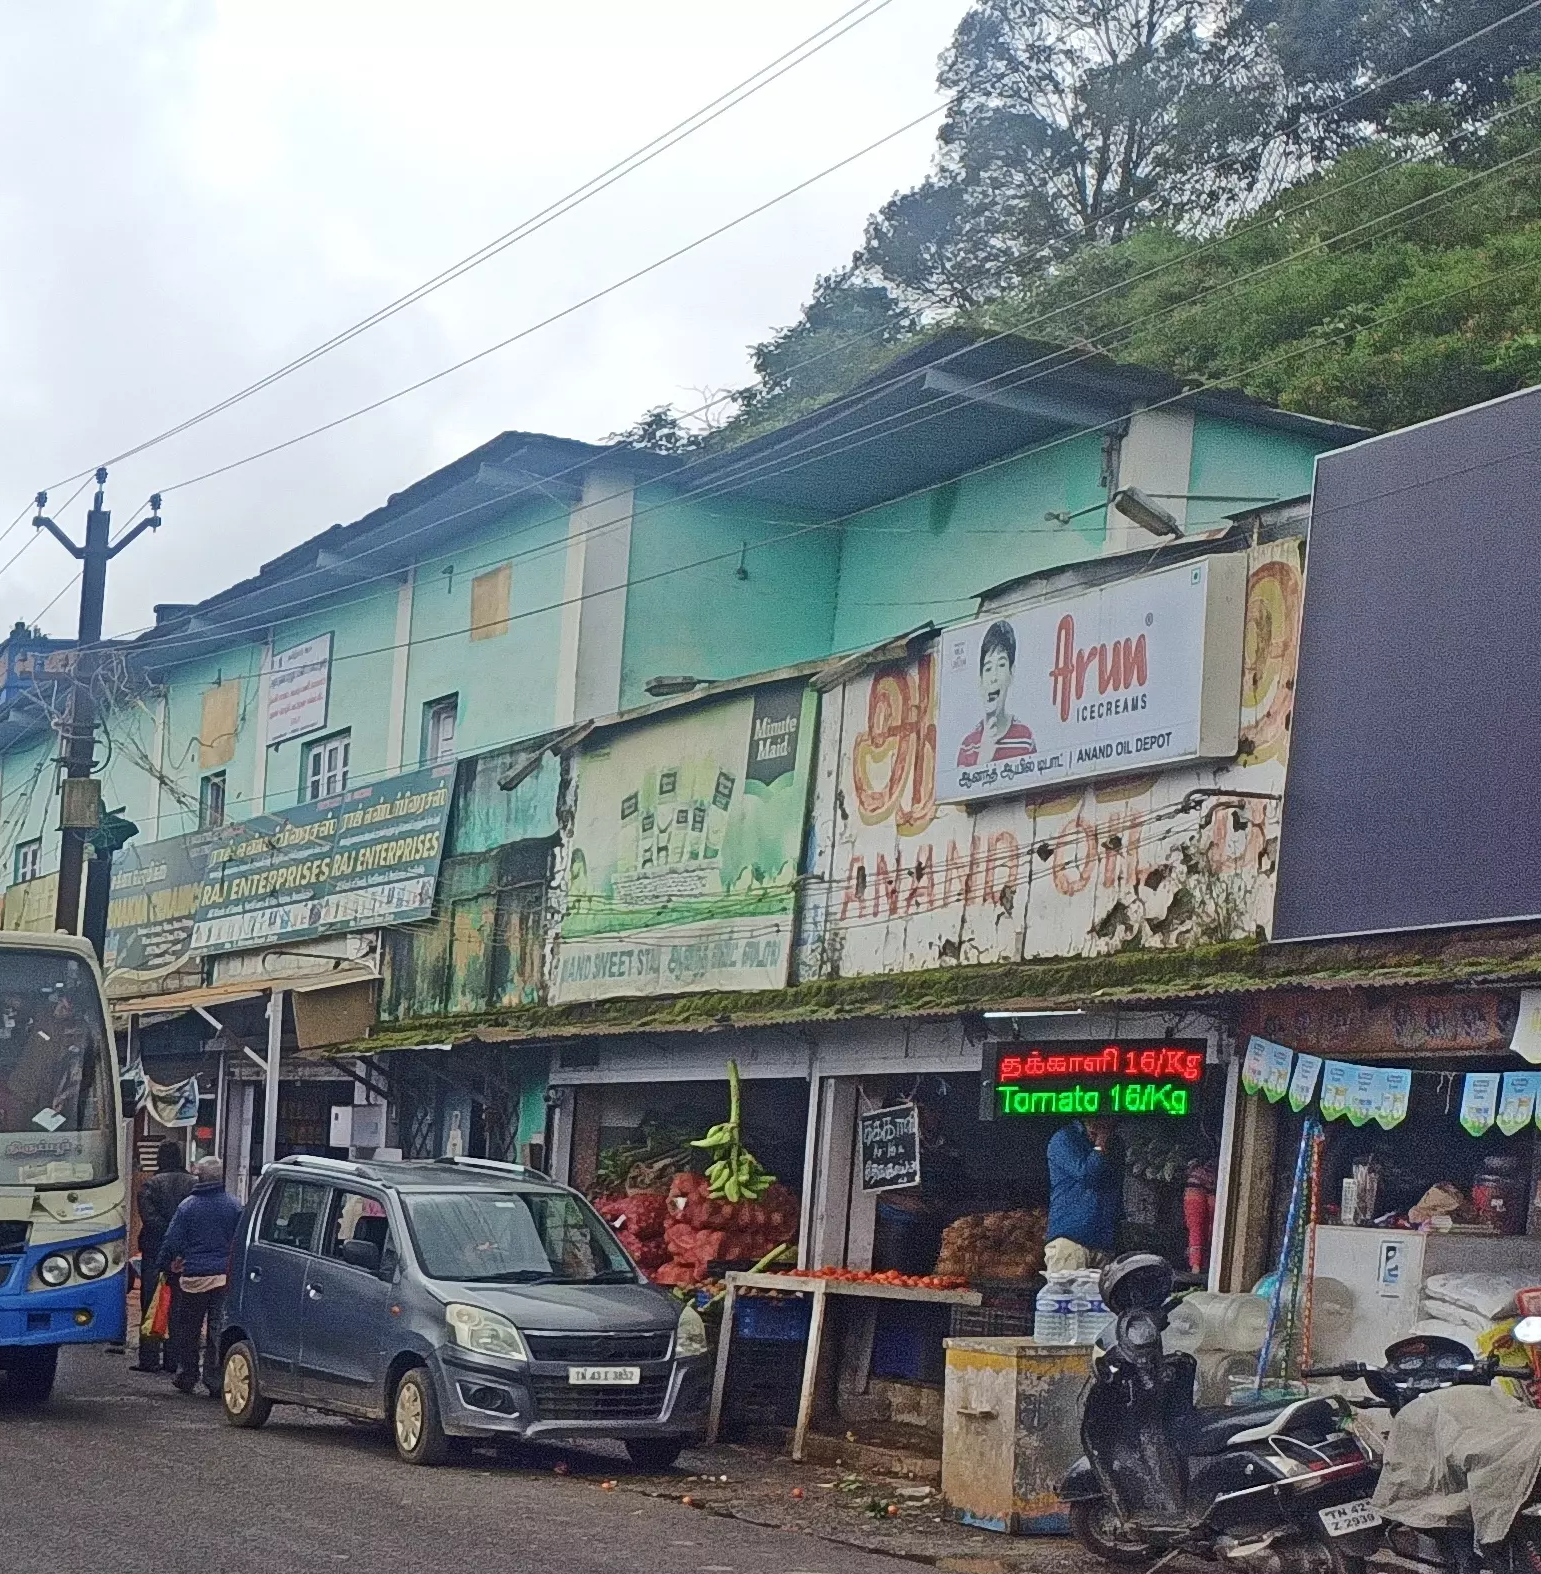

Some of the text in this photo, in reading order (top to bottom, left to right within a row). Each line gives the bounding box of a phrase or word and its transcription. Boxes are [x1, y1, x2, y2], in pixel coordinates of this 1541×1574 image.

[1049, 614, 1147, 722] Arun
[1076, 693, 1147, 723] ICECREAMS
[754, 714, 797, 739] Minute
[757, 735, 788, 760] Maid
[1076, 743, 1114, 763] ANAND
[1135, 731, 1173, 753] DEPOT
[332, 851, 355, 877] RAJ
[356, 831, 440, 872] ENTERPRISES
[201, 880, 229, 906] RAJ
[231, 857, 330, 900] ENTERPRISES
[840, 830, 1018, 921] ANAND
[593, 949, 634, 979] SWEET
[1001, 1048, 1118, 1081] தக்காளி
[1125, 1048, 1201, 1079] 16/Kg
[997, 1084, 1188, 1114] Tomato 16/Kg
